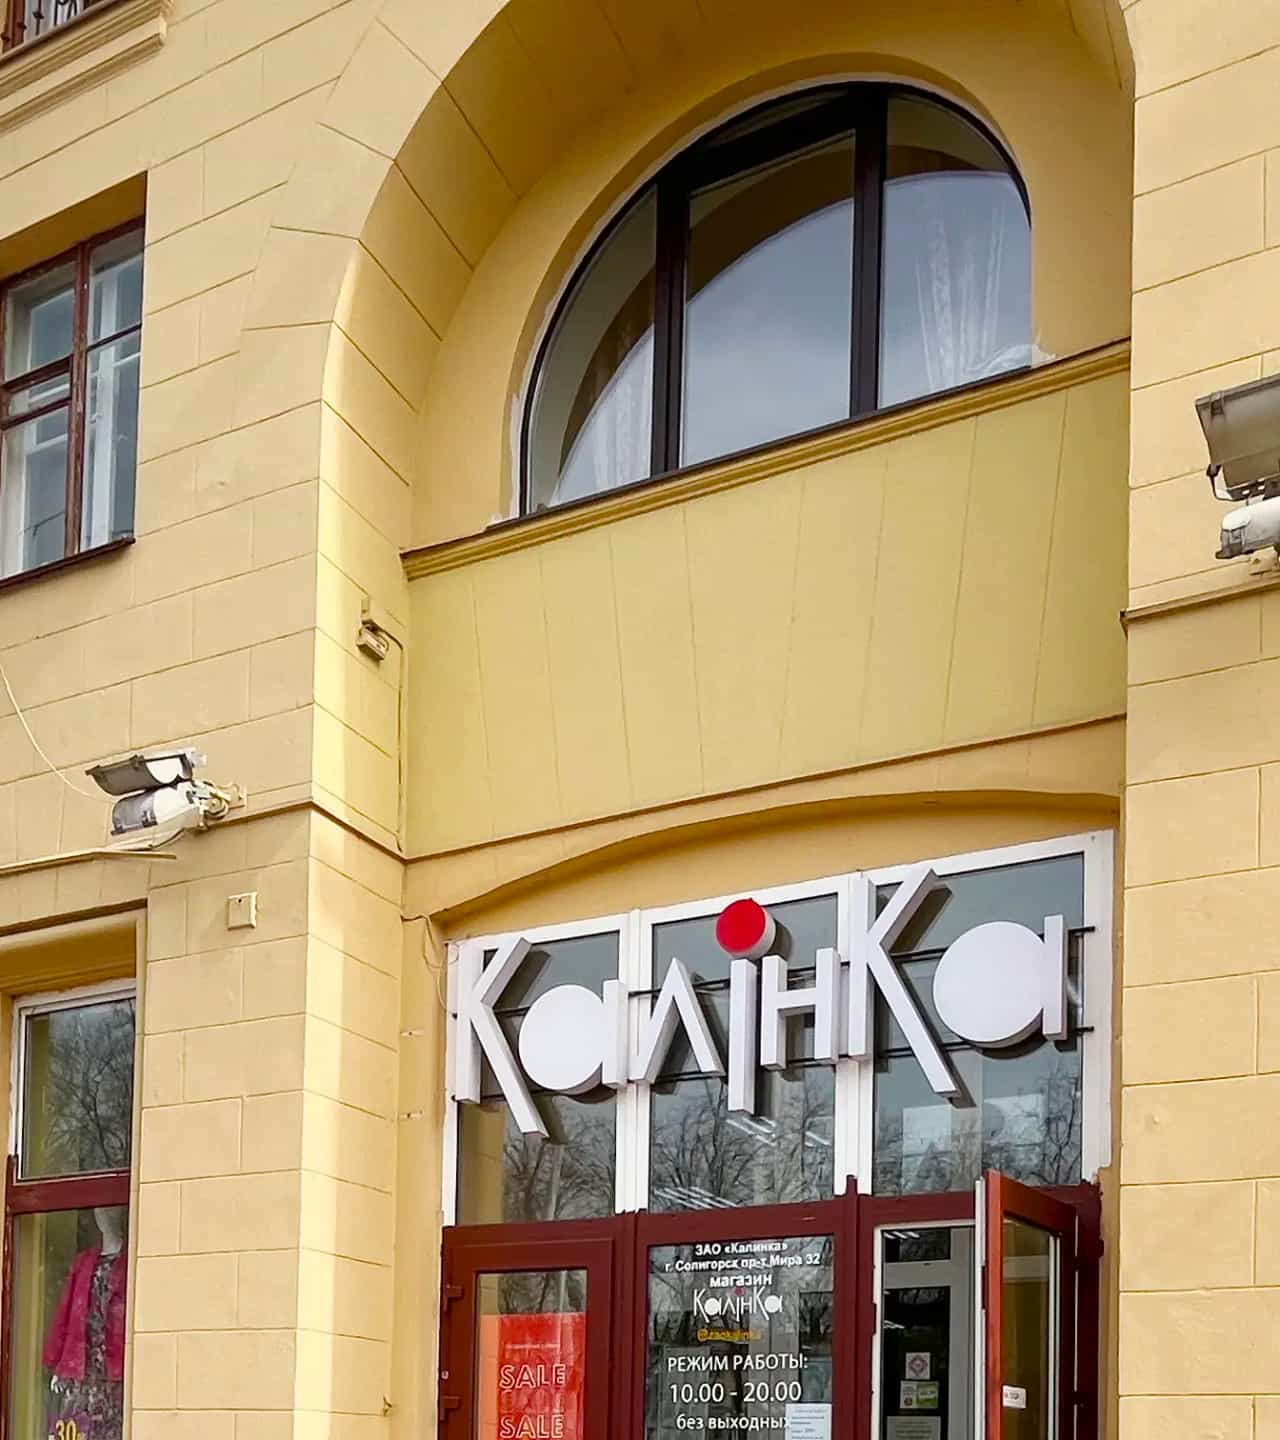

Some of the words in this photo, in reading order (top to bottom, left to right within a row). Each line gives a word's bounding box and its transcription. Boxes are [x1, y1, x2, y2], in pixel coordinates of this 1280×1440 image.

[695, 1243, 721, 1256] ЗАО
[675, 1259, 739, 1271] Солигорск
[770, 1254, 803, 1268] Мира
[806, 1253, 820, 1265] 32
[710, 1274, 772, 1288] магазин
[668, 1355, 728, 1372] РЕЖИМ
[733, 1353, 808, 1370] РАБОТЫ:
[499, 1364, 566, 1389] SALE
[670, 1383, 724, 1403] 10.00
[744, 1381, 802, 1403] 20.00
[499, 1414, 565, 1439] SALE
[676, 1413, 704, 1431] без
[708, 1416, 792, 1431] выходных
